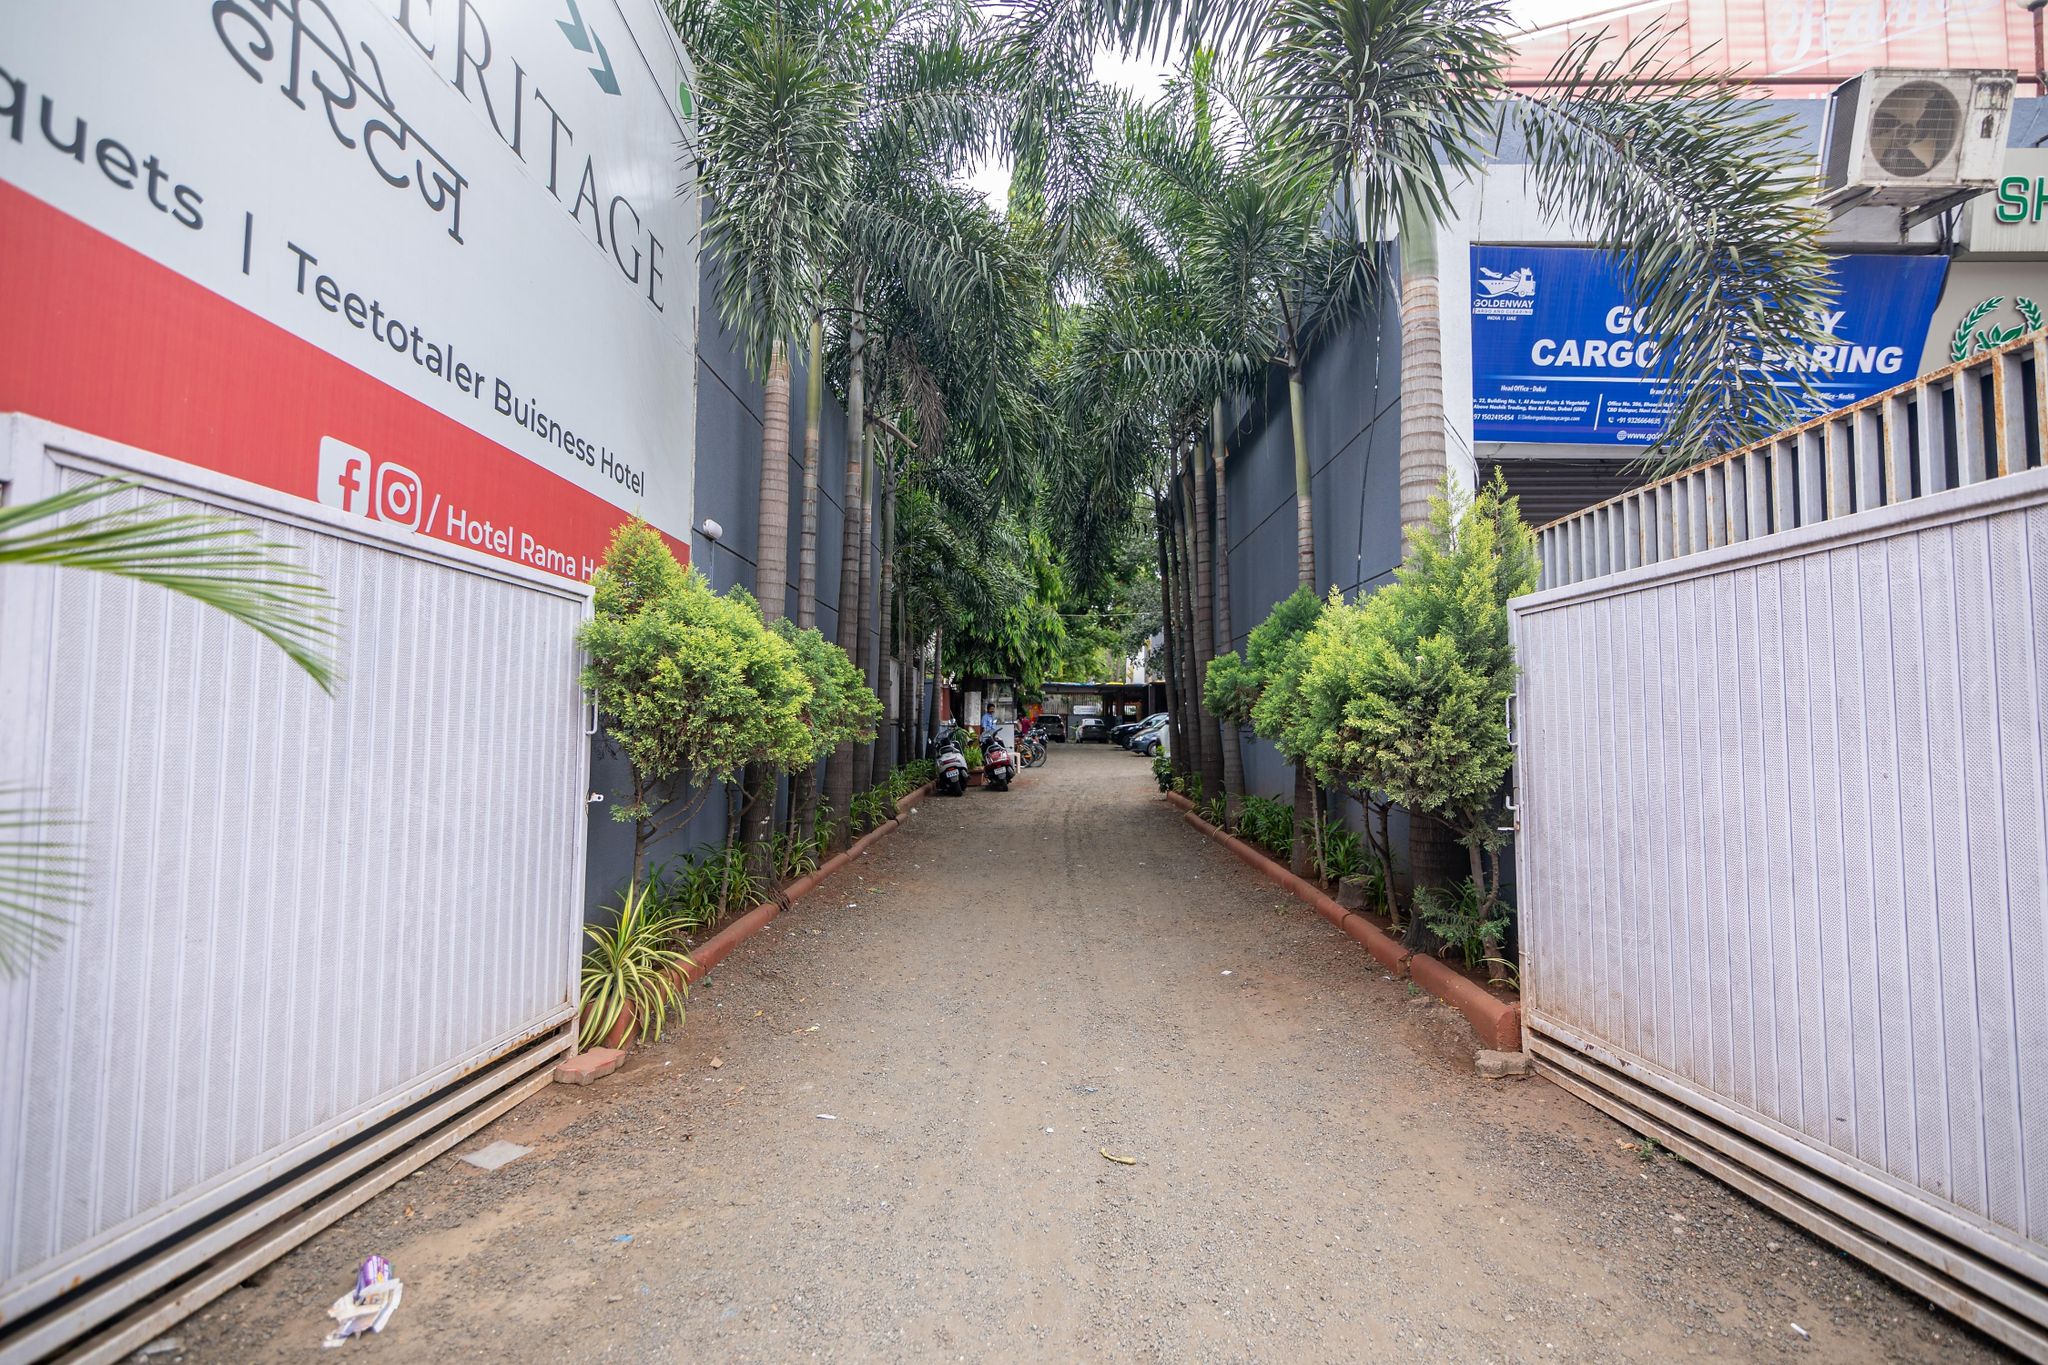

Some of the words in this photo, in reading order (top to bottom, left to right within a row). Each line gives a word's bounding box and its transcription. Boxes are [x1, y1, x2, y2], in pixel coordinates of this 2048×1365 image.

[1473, 299, 1534, 309] GOLDENWAY
[287, 241, 485, 399] Teetotaler
[494, 377, 595, 467] Buisness
[601, 447, 645, 497] Hotel
[1531, 338, 1661, 368] CARGO
[446, 505, 513, 556] Hotel
[520, 533, 576, 577] Rama
